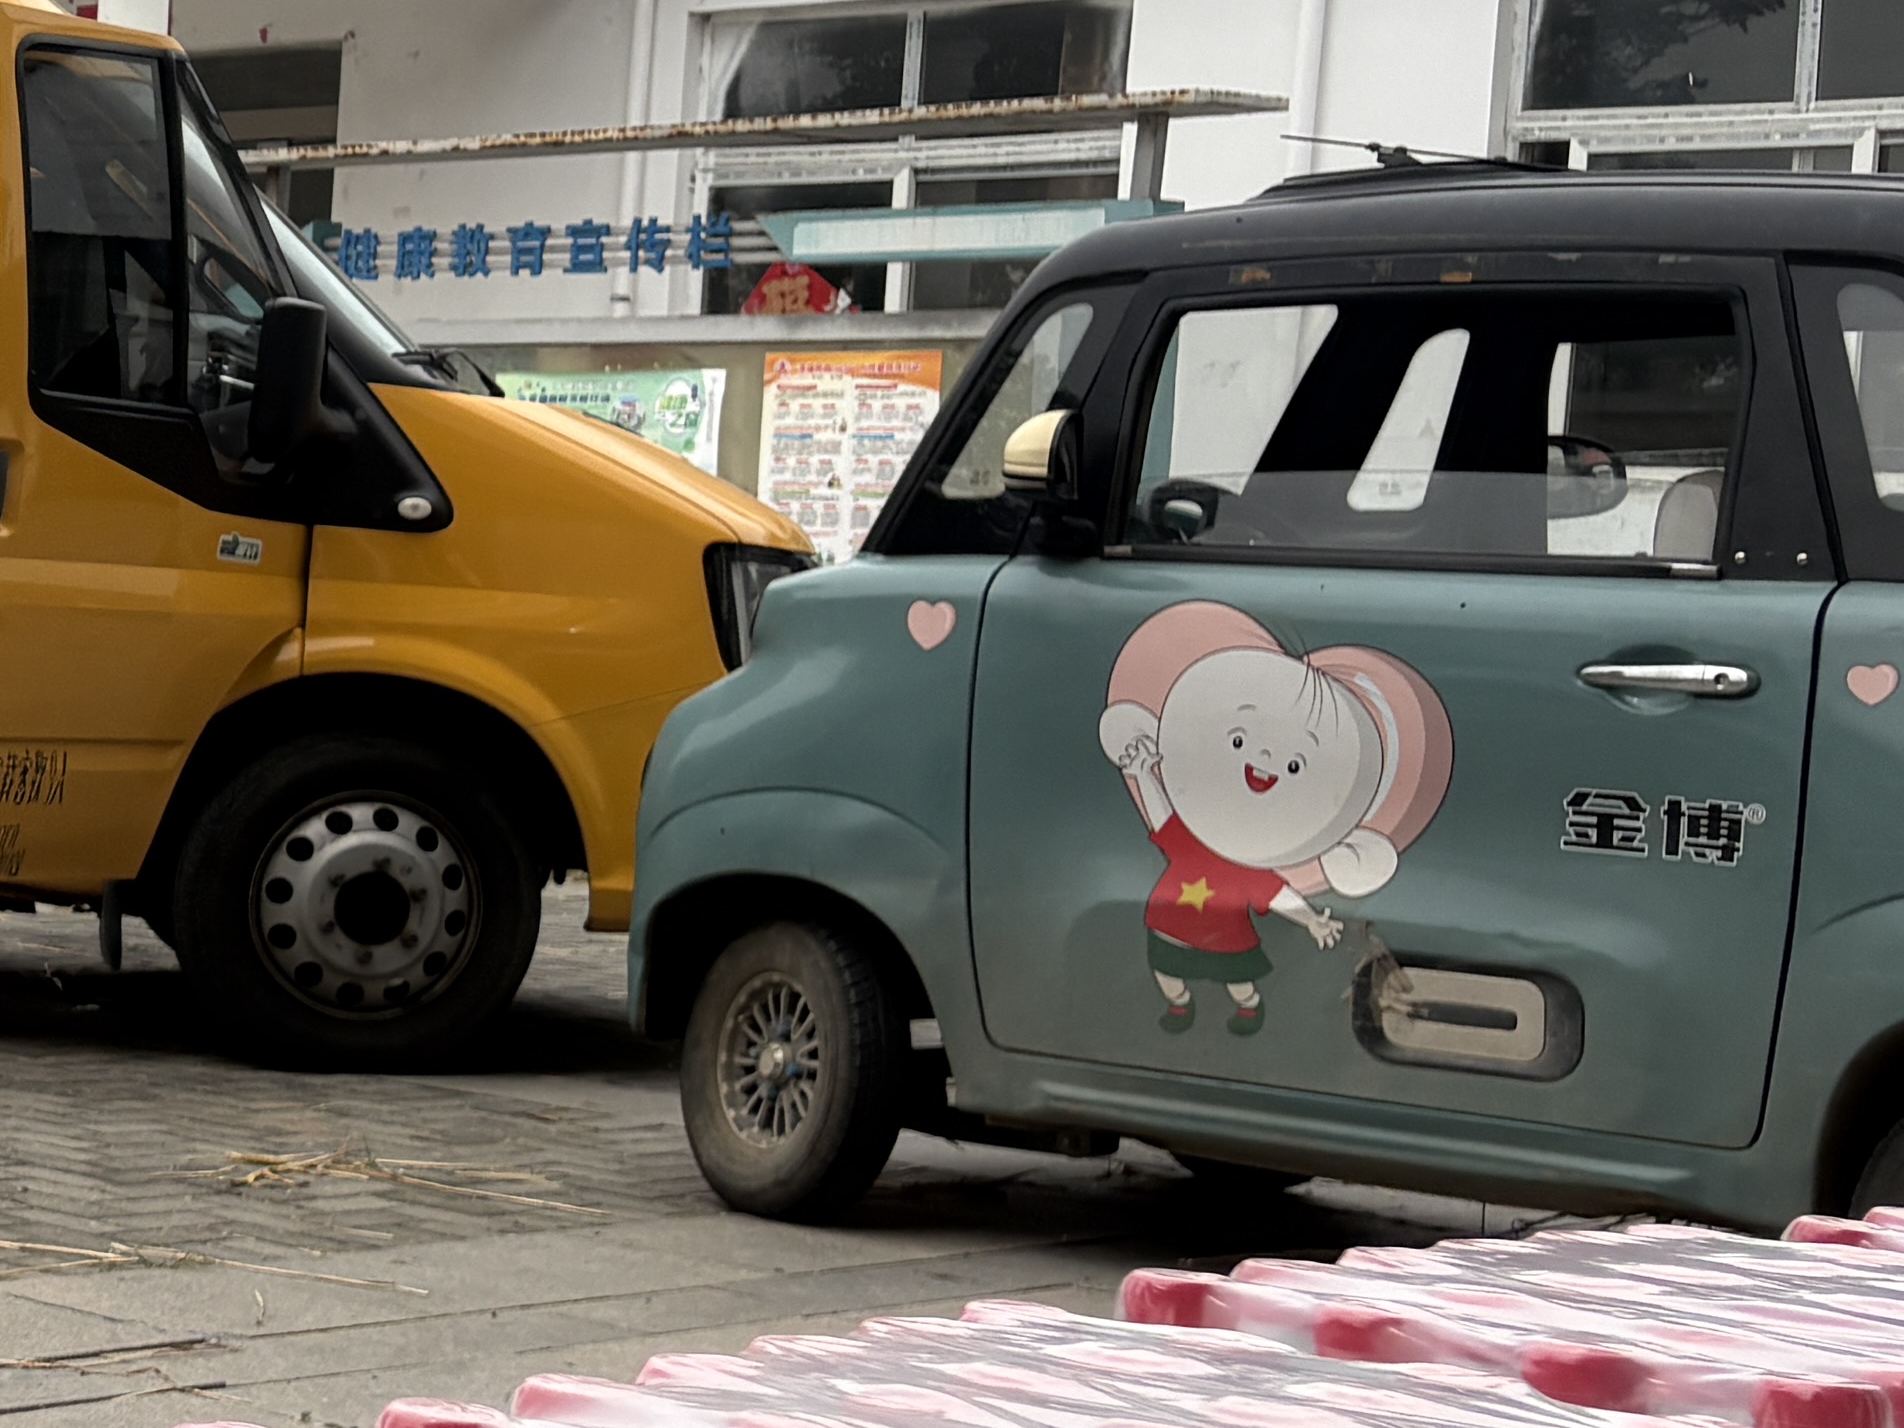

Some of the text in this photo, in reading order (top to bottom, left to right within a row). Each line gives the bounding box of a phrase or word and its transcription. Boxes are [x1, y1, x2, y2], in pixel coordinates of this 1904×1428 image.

[338, 213, 733, 281] 健康教育宣传栏
